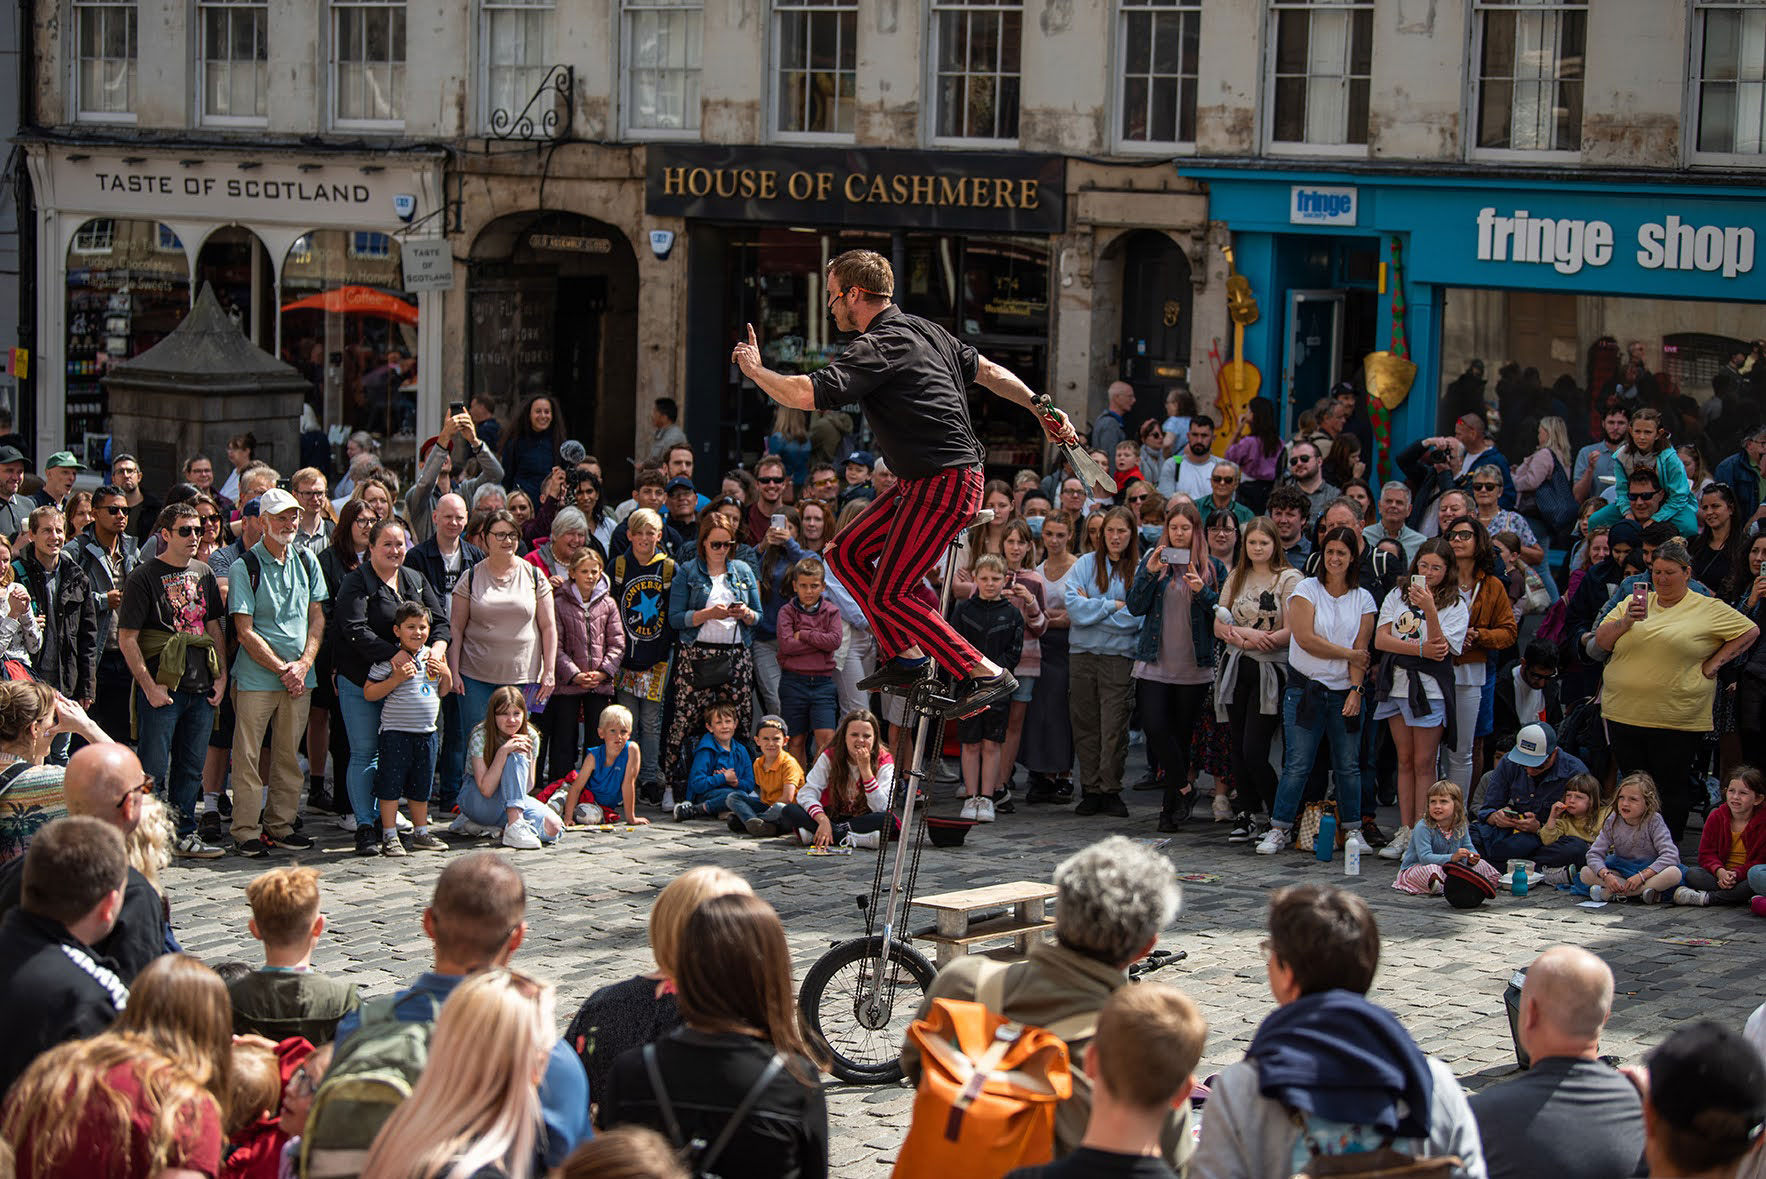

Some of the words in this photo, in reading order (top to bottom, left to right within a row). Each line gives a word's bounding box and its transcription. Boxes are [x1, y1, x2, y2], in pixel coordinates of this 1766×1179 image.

[95, 173, 173, 194] TASTE
[184, 178, 216, 195] OF
[227, 180, 370, 203] SCOTLAND
[663, 166, 778, 199] HOUSE
[788, 171, 834, 201] OF
[844, 173, 1040, 209] CASHMERE
[1297, 189, 1352, 217] fringe
[413, 248, 440, 257] TASTE
[1477, 207, 1614, 274] fringe
[1637, 215, 1755, 277] shop
[421, 261, 433, 270] OF
[406, 273, 452, 283] SCOTLAND
[346, 288, 384, 305] Coffee
[625, 580, 663, 609] CONVERSE
[636, 626, 652, 635] ALL
